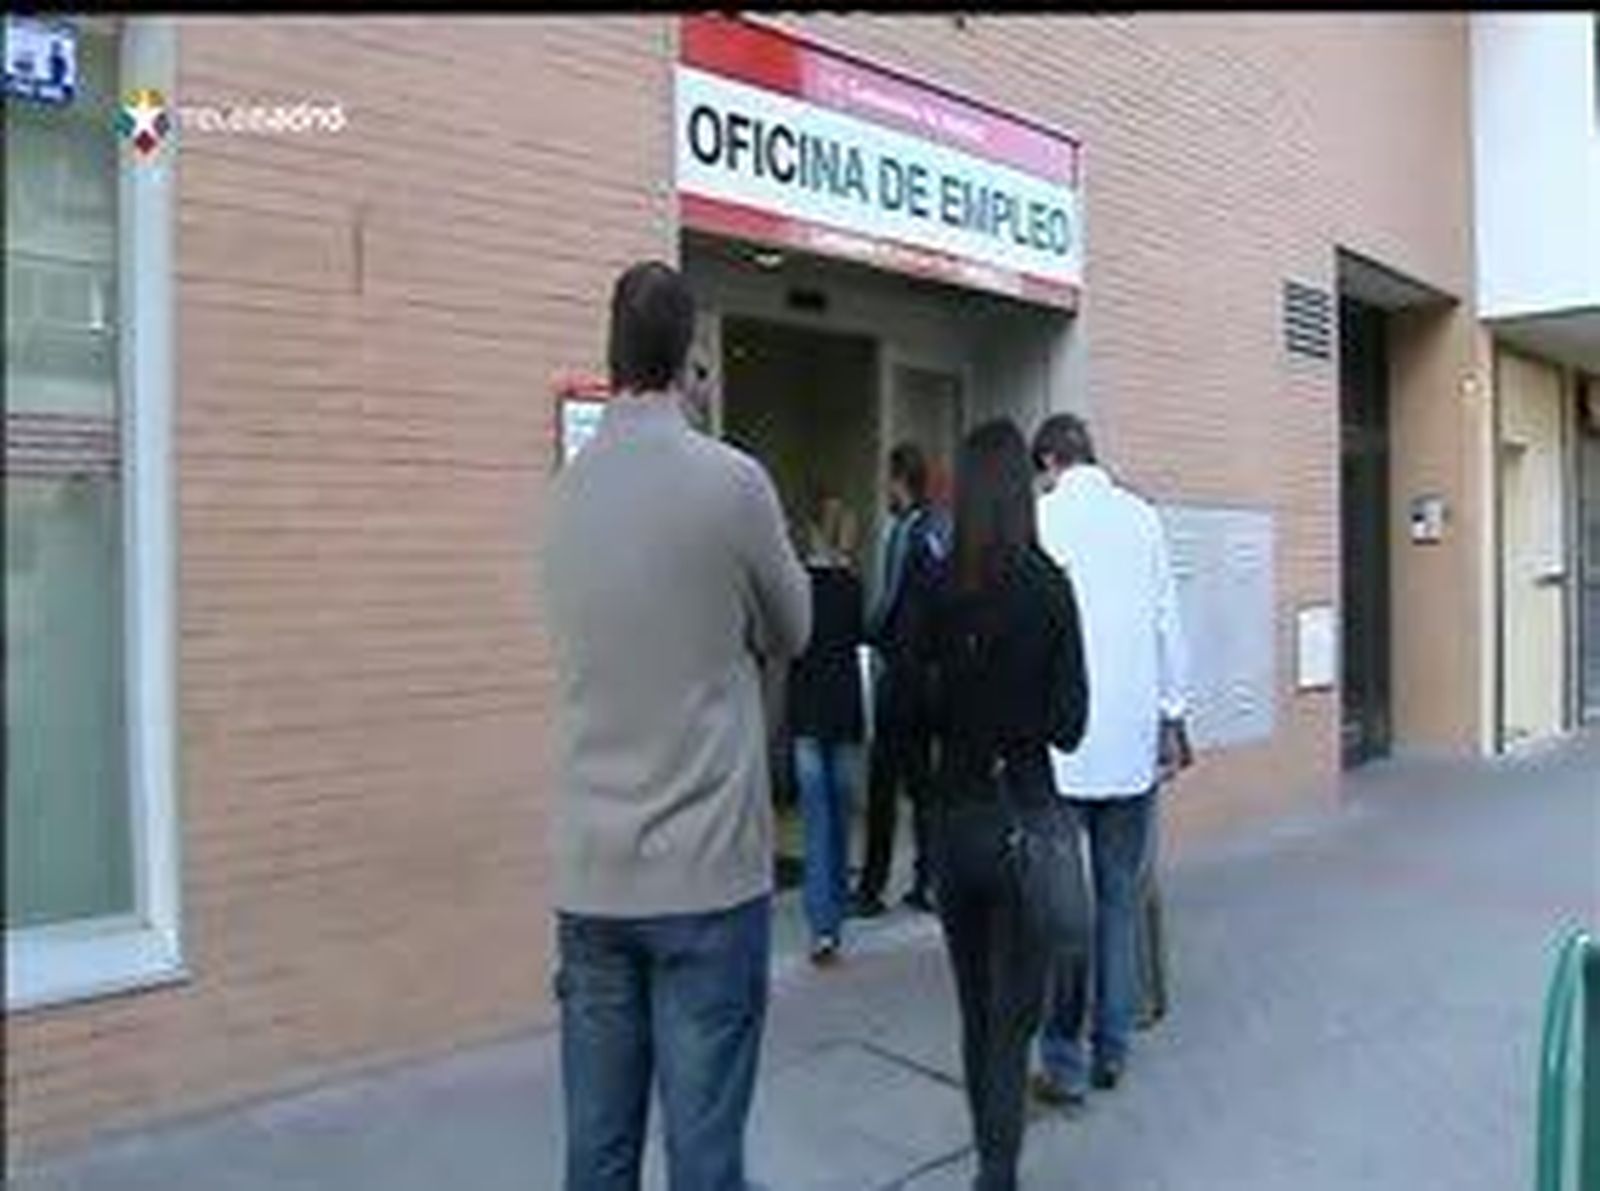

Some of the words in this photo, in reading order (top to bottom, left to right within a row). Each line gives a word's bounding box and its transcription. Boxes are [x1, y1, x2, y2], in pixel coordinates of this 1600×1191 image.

[688, 105, 869, 202] OFICINA
[878, 157, 929, 218] DE
[940, 174, 1070, 257] EMPLEO
